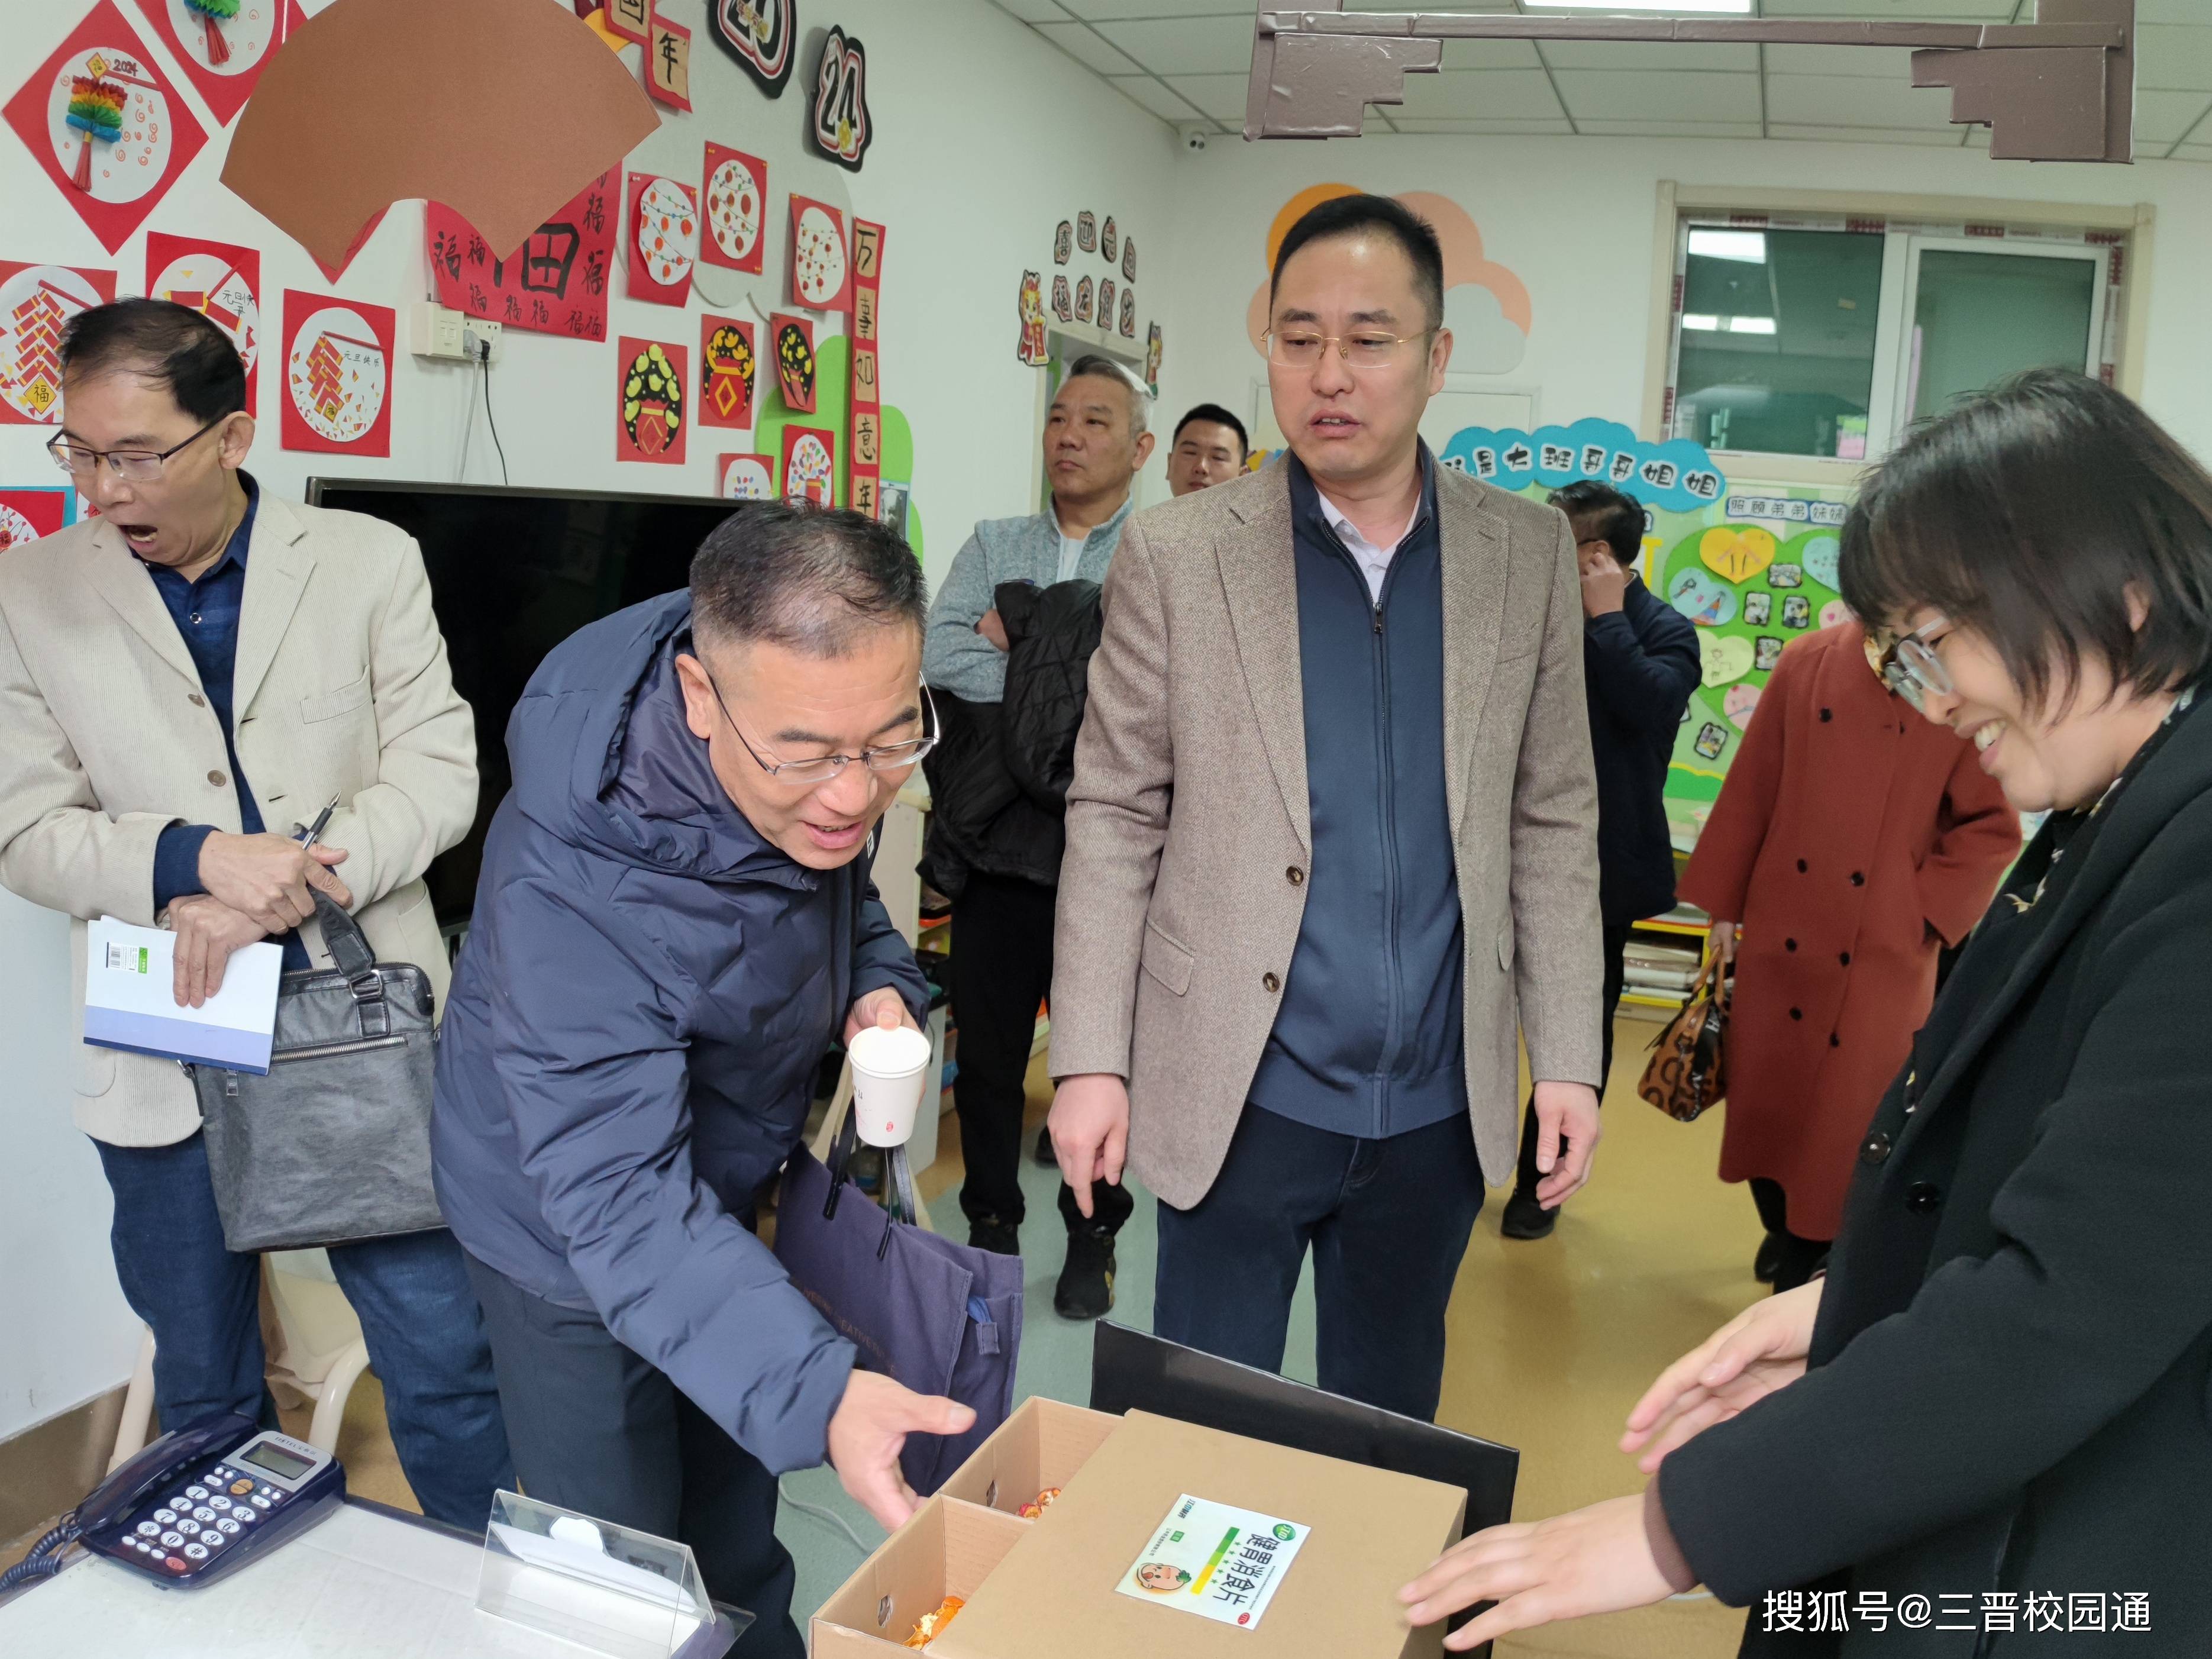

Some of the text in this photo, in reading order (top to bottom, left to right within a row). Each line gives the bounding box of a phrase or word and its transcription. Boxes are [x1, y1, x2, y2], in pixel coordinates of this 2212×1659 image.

[343, 351, 380, 367] 元旦快乐
[34, 385, 49, 403] 福
[1213, 1533, 1281, 1605] 健胃消食片
